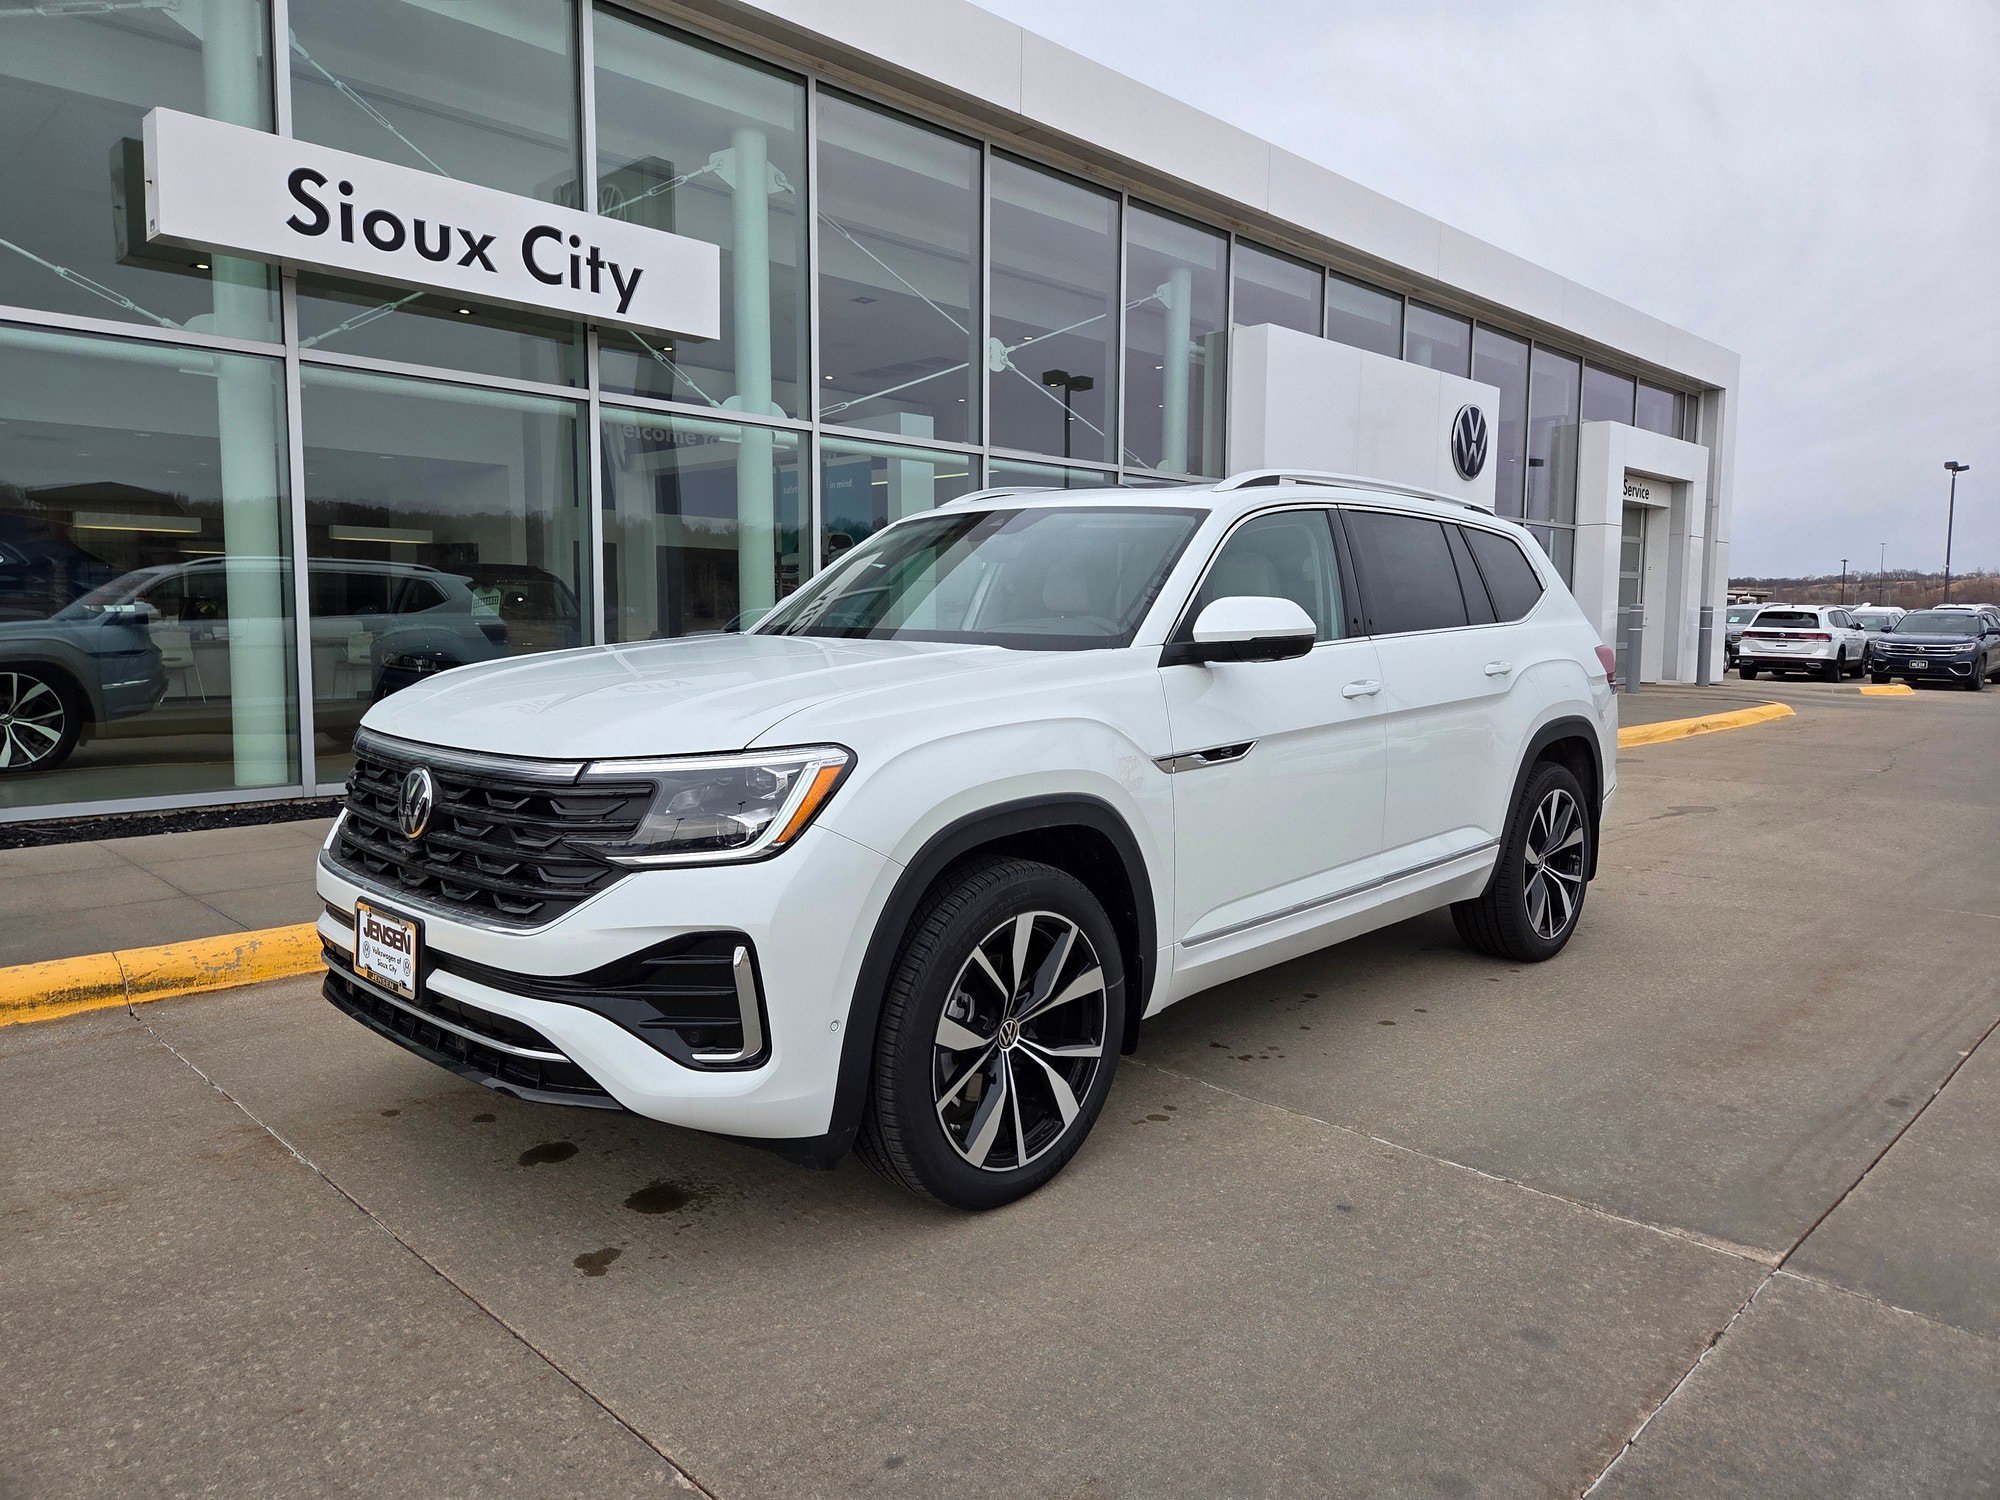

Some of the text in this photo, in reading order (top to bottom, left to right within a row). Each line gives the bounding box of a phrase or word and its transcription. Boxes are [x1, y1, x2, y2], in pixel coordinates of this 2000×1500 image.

[285, 167, 644, 314] Sioux City
[1622, 478, 1649, 499] Service
[363, 918, 411, 955] JENSEN
[371, 945, 402, 965] Volkswagen of
[377, 958, 398, 976] Sioux City
[371, 974, 394, 990] JENSEN
